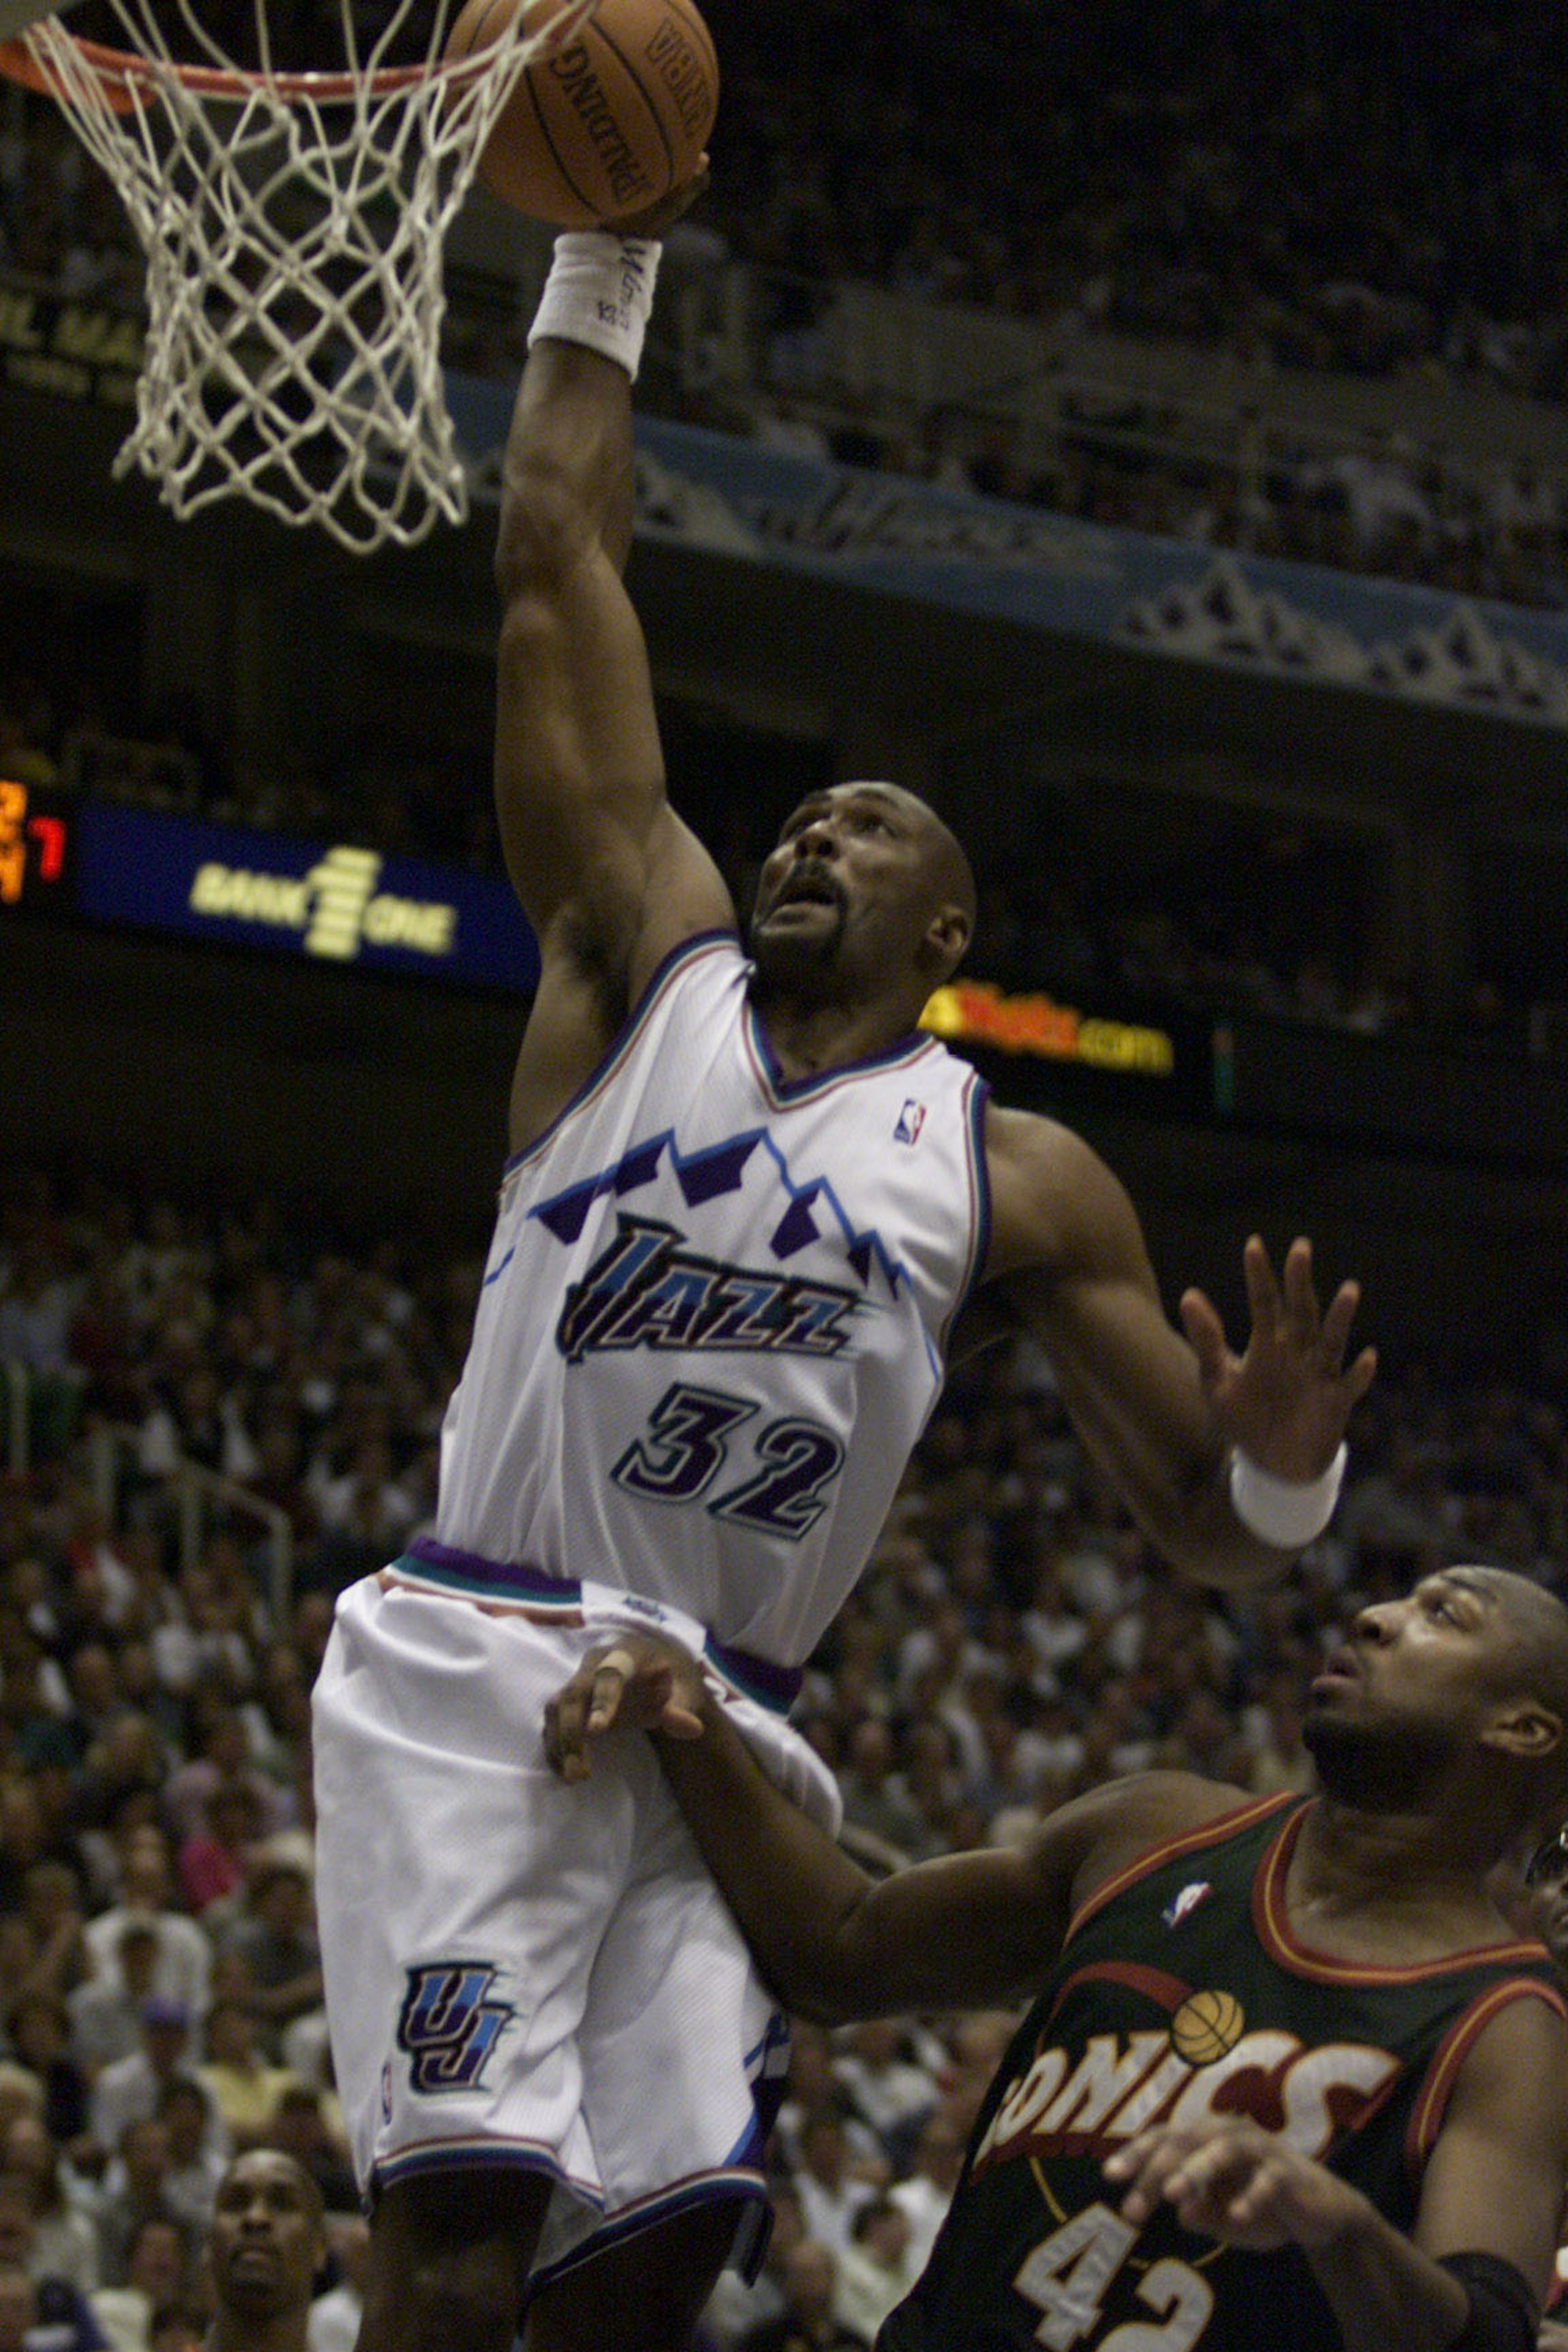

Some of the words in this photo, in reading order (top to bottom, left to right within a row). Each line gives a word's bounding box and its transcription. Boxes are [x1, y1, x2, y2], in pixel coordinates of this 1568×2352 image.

[556, 1212, 861, 1365] JAZZ
[610, 1382, 845, 1542] 32
[1014, 2201, 1216, 2352] 42
